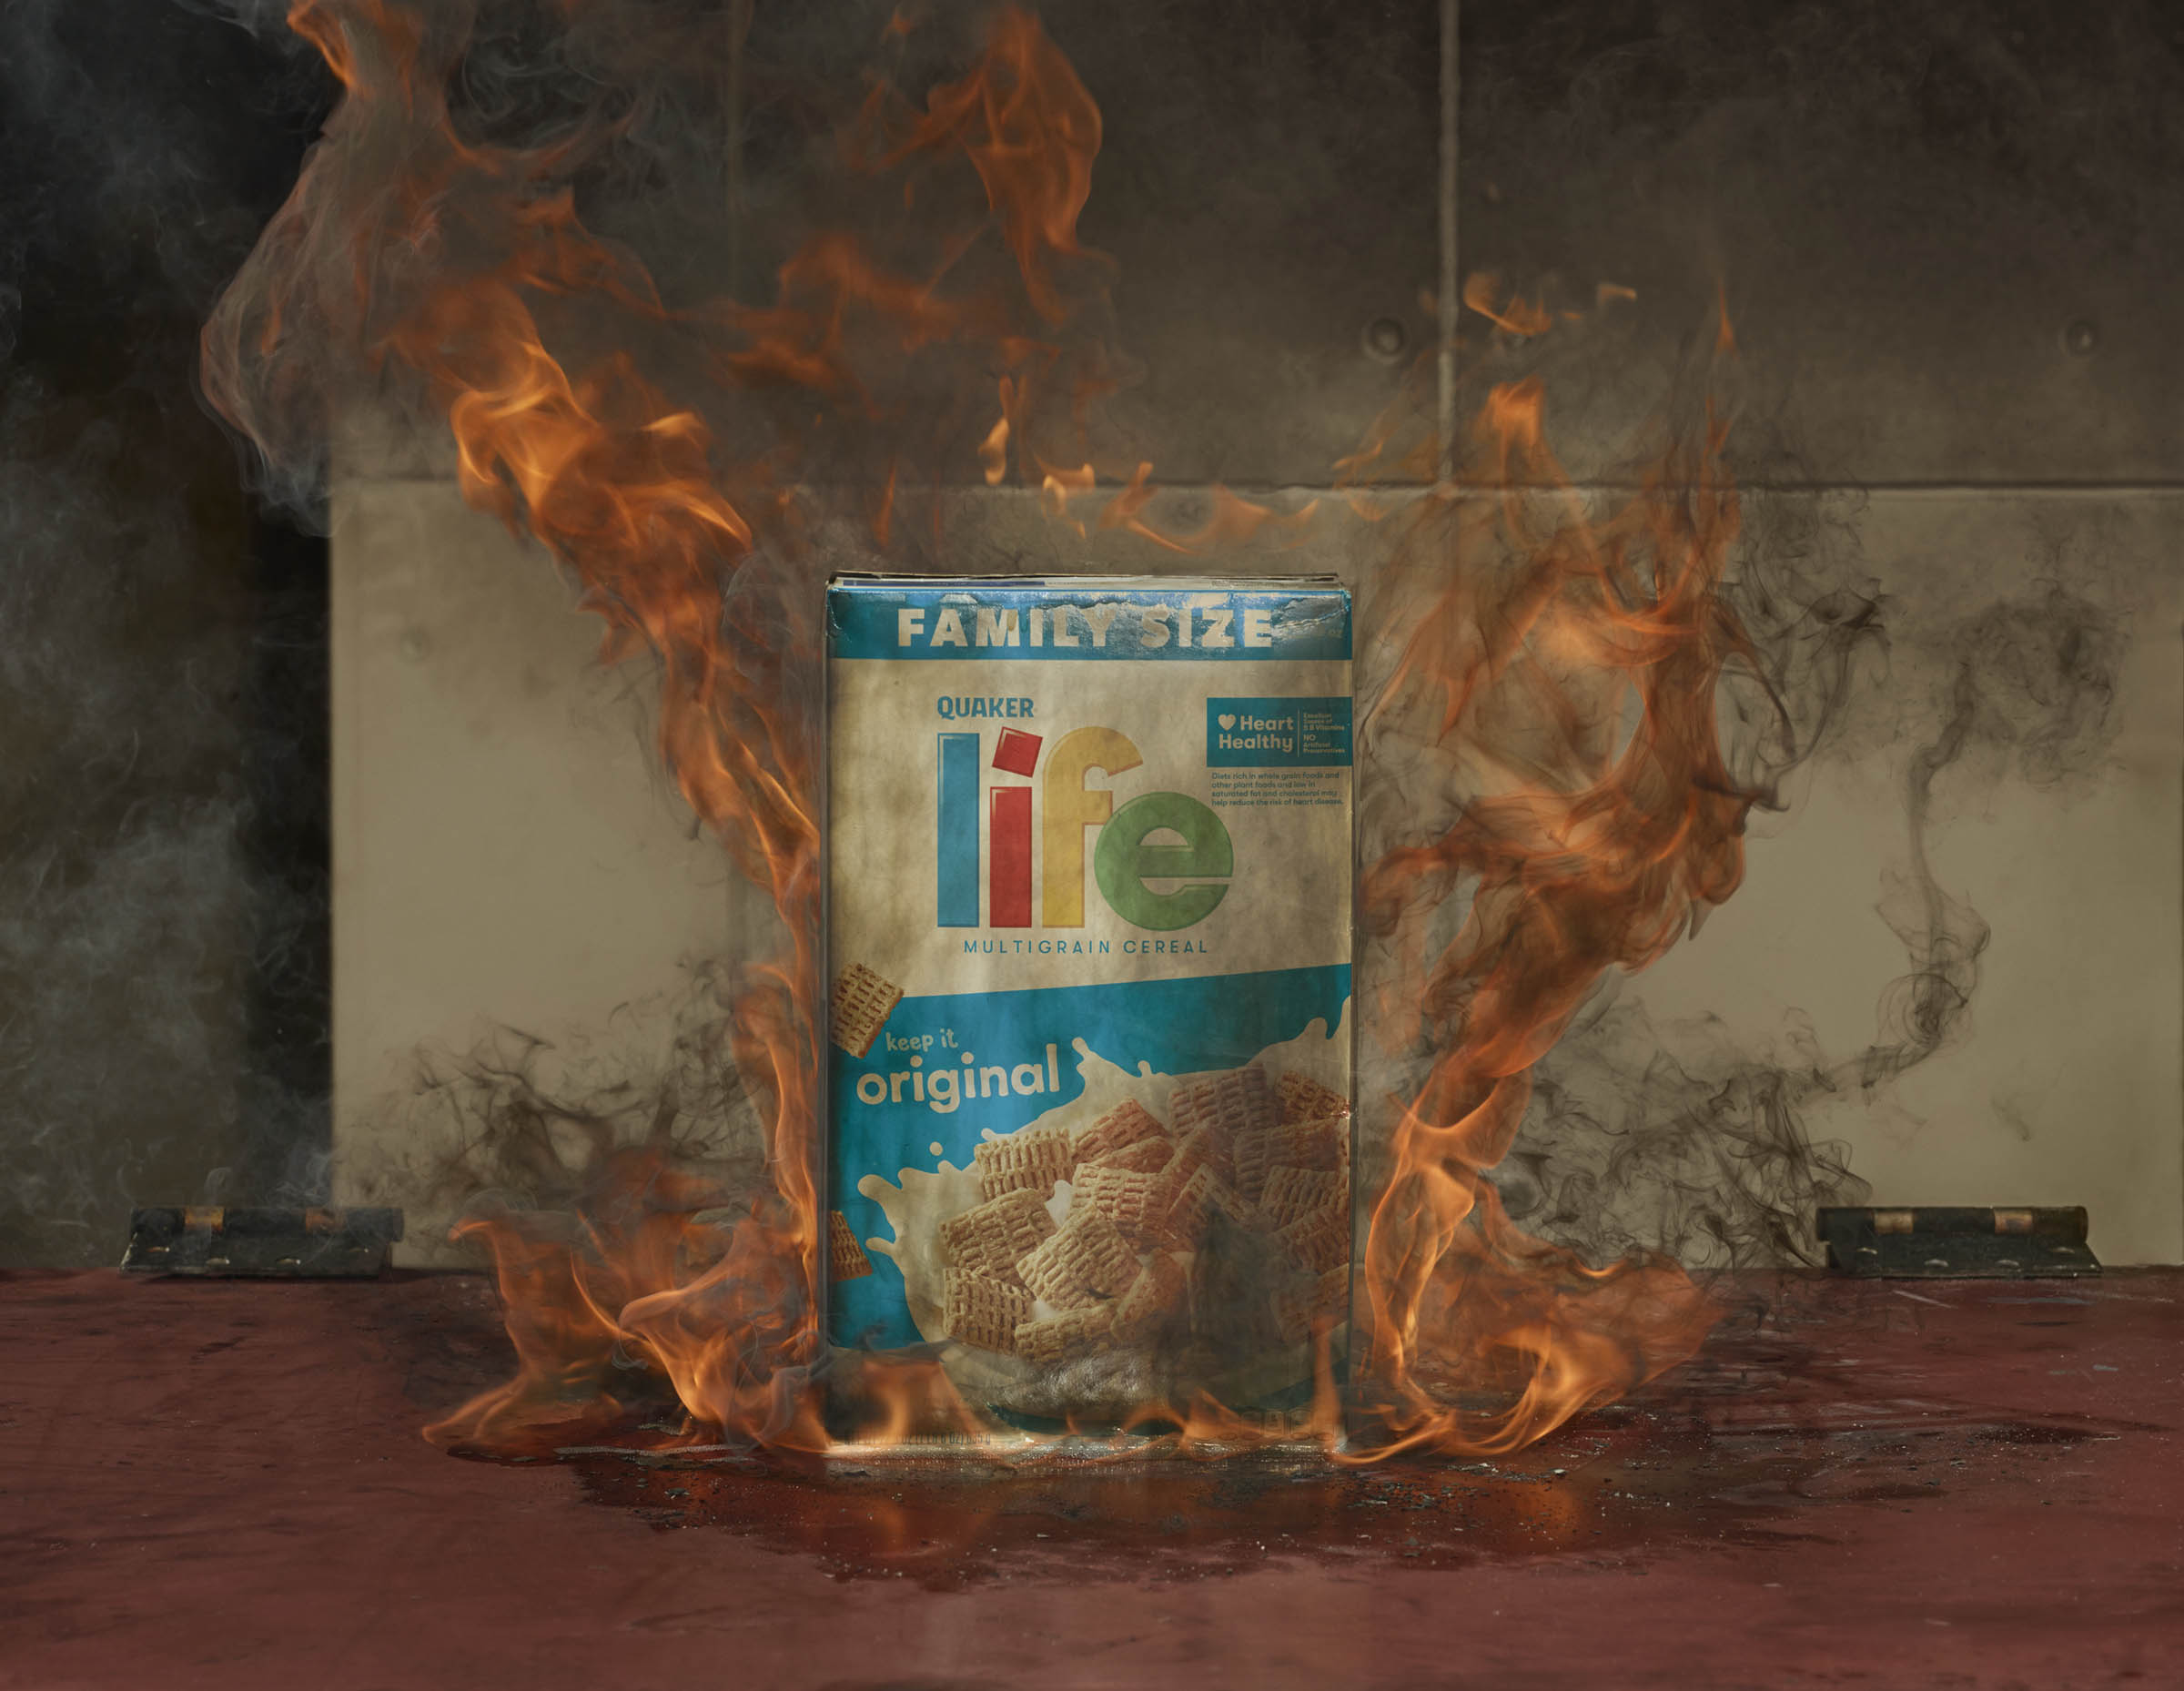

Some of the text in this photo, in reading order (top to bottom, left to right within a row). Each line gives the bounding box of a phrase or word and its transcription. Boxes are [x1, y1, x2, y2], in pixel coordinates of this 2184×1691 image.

[898, 607, 1273, 648] FAMILY SIZE
[936, 695, 1035, 720] QUAKER
[1240, 714, 1294, 731] Heart
[1218, 734, 1293, 753] Healthy
[1303, 734, 1316, 742] NO
[1234, 781, 1253, 789] plant
[936, 726, 1235, 932] life
[963, 939, 1208, 954] MULTIGRAIN CEREAL
[885, 1028, 959, 1054] keep it
[855, 1043, 1060, 1114] original
